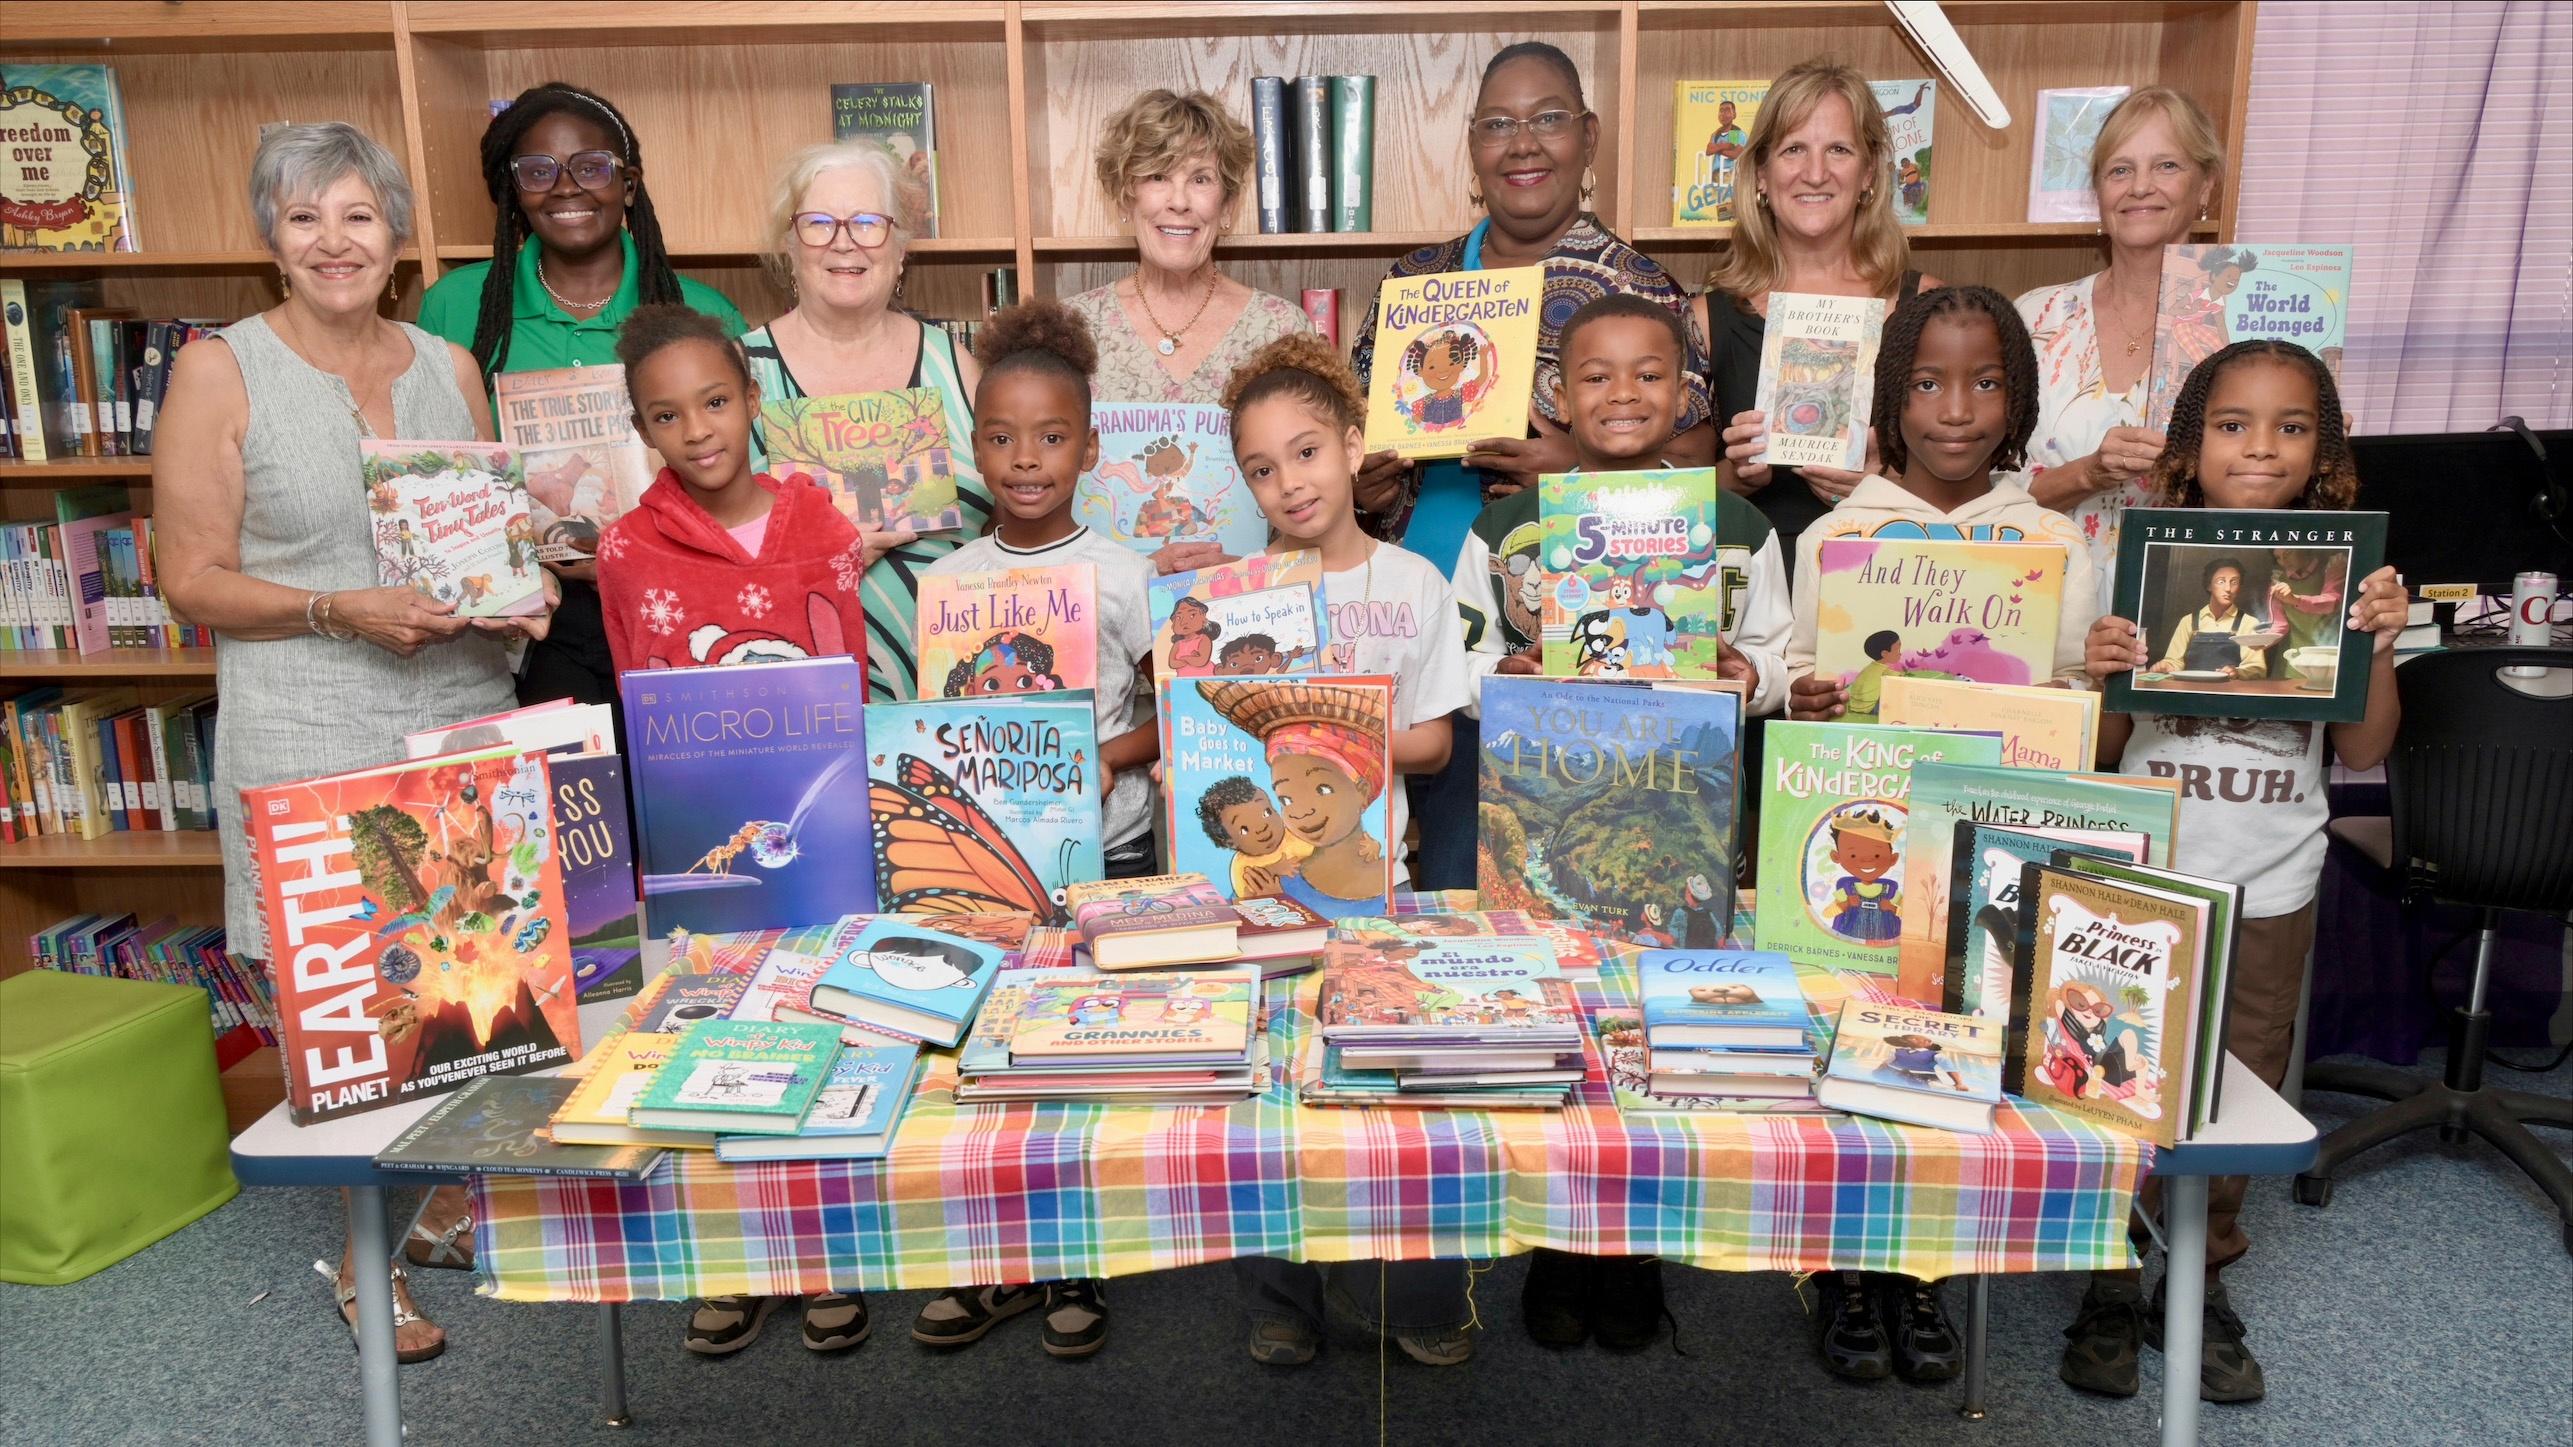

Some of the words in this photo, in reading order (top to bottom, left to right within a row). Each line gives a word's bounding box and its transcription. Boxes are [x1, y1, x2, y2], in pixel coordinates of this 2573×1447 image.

[836, 96, 877, 110] CELERY
[883, 95, 923, 110] STALKS
[1690, 91, 1714, 103] NIC
[838, 114, 853, 128] AT
[859, 111, 922, 128] MIDNIGHT
[12, 147, 52, 161] over
[21, 166, 49, 181] me
[4, 207, 41, 225] Ashley
[41, 207, 75, 222] Bryan
[2262, 248, 2306, 257] Jacqueline
[2307, 249, 2344, 257] Woodson
[1400, 289, 1420, 300] The
[1423, 278, 1491, 302] QUEEN
[1494, 280, 1510, 293] of
[2255, 281, 2278, 291] The
[1816, 299, 1837, 309] MY
[2246, 293, 2311, 313] World
[1788, 311, 1862, 324] BROTHER'S
[2236, 314, 2325, 336] Belonged
[1805, 325, 1841, 336] BOOK
[509, 399, 537, 421] THE
[541, 395, 574, 417] TRUE
[830, 401, 846, 411] the
[848, 398, 882, 424] CITY
[513, 424, 542, 446] THE
[545, 422, 555, 442] 3
[557, 416, 604, 441] LITTLE
[811, 411, 899, 452] Tree
[1091, 409, 1186, 435] GRANDMA'S
[1778, 437, 1840, 451] MAURICE
[1780, 451, 1834, 463] SENDAK
[413, 496, 447, 520] Ten
[448, 482, 491, 508] Word
[421, 519, 474, 544] Tiny
[463, 501, 506, 528] Tales
[2146, 526, 2194, 539] THE
[2216, 529, 2355, 542] STRANGER
[955, 579, 985, 592] Vanessa
[1022, 574, 1052, 587] Newton
[1858, 553, 1904, 584] And
[1911, 554, 1967, 594] They
[2428, 589, 2461, 598] Station
[2462, 588, 2468, 597] 2
[930, 600, 981, 636] Just
[989, 594, 1036, 629] Like
[1036, 588, 1081, 636] Me
[1226, 611, 1249, 626] How
[1251, 611, 1261, 623] to
[1265, 604, 1293, 624] Speak
[1296, 603, 1305, 614] in
[1903, 588, 1973, 628] Walk
[1982, 593, 2022, 630] On
[1541, 691, 1554, 699] An
[1556, 692, 1573, 700] Ode
[1587, 694, 1600, 703] the
[1604, 696, 1639, 706] National
[1642, 699, 1665, 708] Parks
[646, 707, 774, 746] MICRO
[784, 702, 854, 736] LIFE
[1180, 716, 1228, 737] Baby
[1527, 705, 1604, 738] YOU
[1613, 713, 1682, 744] ARE
[935, 714, 1061, 760] SEÑORITA
[1199, 737, 1229, 751] Goes
[1234, 740, 1247, 752] to
[648, 752, 692, 761] MIRACLES
[694, 751, 705, 759] OF
[709, 750, 726, 758] THE
[728, 746, 775, 756] MINIATURE
[777, 743, 808, 753] WORLD
[1809, 743, 1841, 760] The
[2002, 735, 2062, 770] Mama
[1182, 751, 1255, 773] Market
[1509, 734, 1700, 796] HOME
[472, 762, 536, 784] Smithsonian
[954, 756, 1082, 796] MARIPOSA
[270, 801, 288, 814] DK
[1941, 799, 1967, 816] the
[1971, 800, 2030, 824] WATER
[558, 820, 614, 872] YOU
[1983, 833, 2030, 849] SHANNON
[1572, 901, 1598, 913] EVAN
[1602, 905, 1629, 917] TURK
[2051, 879, 2096, 897] SHANNON
[2098, 890, 2122, 905] HALE
[2130, 897, 2156, 913] DEAN
[2159, 906, 2186, 920] HALE
[1110, 918, 1143, 927] MEG
[1154, 910, 1216, 922] MEDINA
[2086, 921, 2157, 950] Princess
[272, 812, 390, 1088] EARTH!
[1767, 941, 1804, 954] DERRICK
[1806, 945, 1841, 959] BARNES
[1846, 950, 1884, 963] VANESSA
[2058, 932, 2161, 976] BLACK
[1420, 955, 1515, 965] mundo
[1663, 958, 1774, 975] Odder
[1423, 967, 1528, 978] nuestro
[613, 985, 633, 995] Harris
[734, 1024, 804, 1034] DIARY
[1858, 1011, 1984, 1038] SECRET
[1883, 1024, 1960, 1039] LIBRARY
[703, 1037, 776, 1050] Wimpy
[777, 1039, 816, 1051] Kid
[1050, 1039, 1084, 1047] AND
[1087, 1038, 1143, 1046] OTHER
[1146, 1036, 1214, 1045] STORIES
[1064, 1029, 1203, 1041] GRANNIES
[401, 1080, 415, 1093] AS
[489, 1057, 516, 1075] SEEN
[517, 1054, 528, 1068] IT
[529, 1045, 567, 1065] BEFORE
[429, 1062, 453, 1076] OUR
[454, 1053, 500, 1073] EXCITING
[502, 1043, 537, 1061] WORLD
[855, 1062, 895, 1074] Kid
[311, 1076, 391, 1114] PLANET
[389, 1134, 410, 1153] MAL
[409, 1125, 430, 1144] PEET
[431, 1096, 462, 1124] ELSPETH
[459, 1075, 492, 1102] GRAHAM
[2116, 1115, 2143, 1130] PHAM
